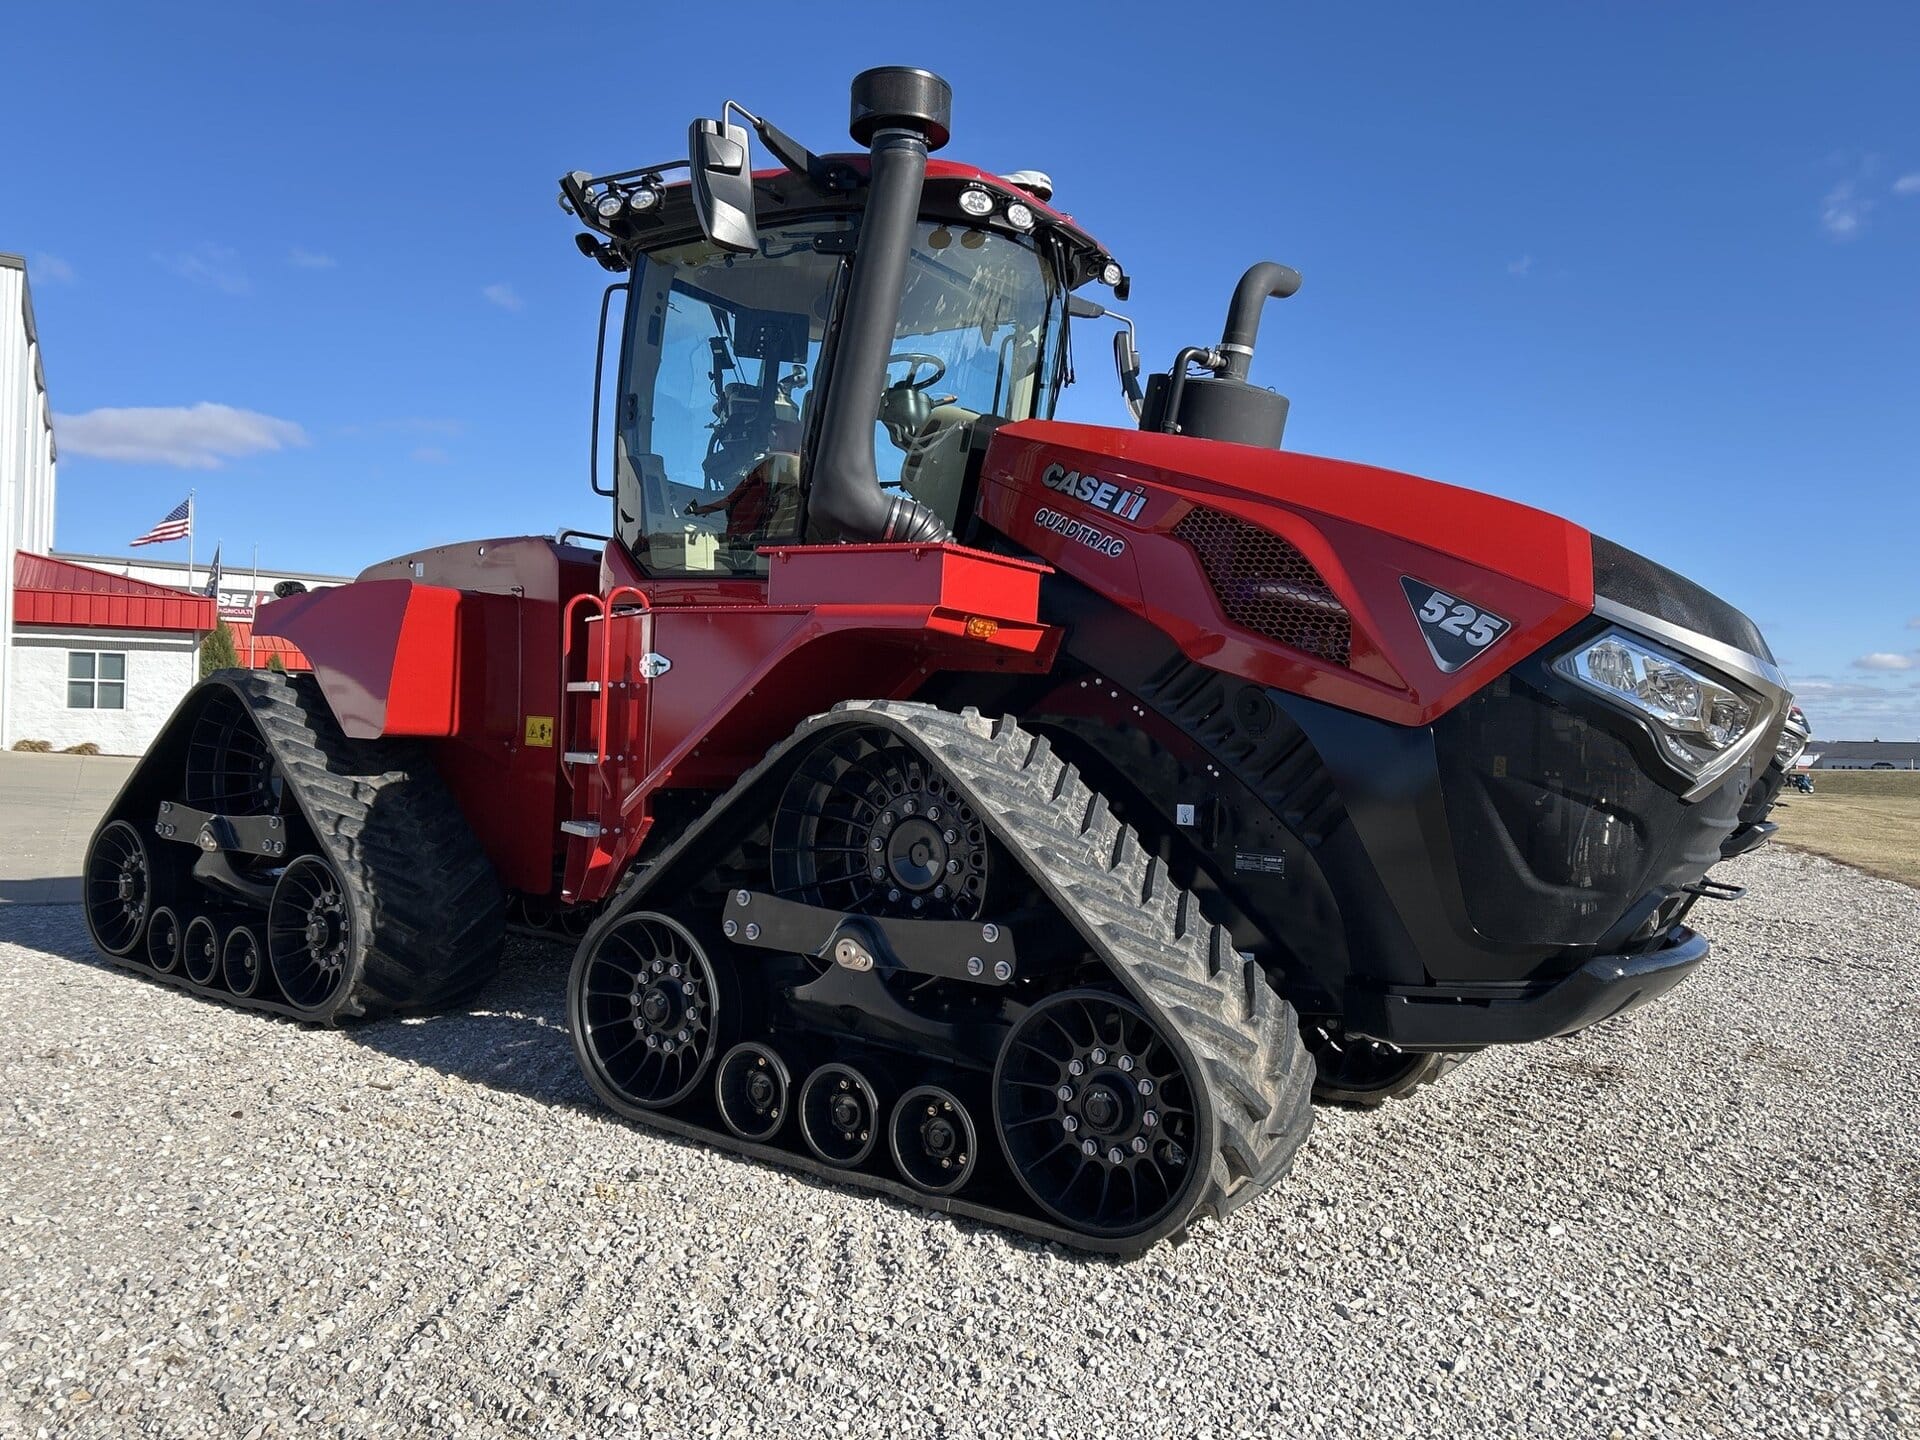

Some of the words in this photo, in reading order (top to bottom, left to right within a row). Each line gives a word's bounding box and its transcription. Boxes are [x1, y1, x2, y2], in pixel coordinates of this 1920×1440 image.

[1041, 462, 1119, 510] CASE
[1034, 507, 1126, 557] QUADTRAC
[218, 592, 248, 607] SE
[1419, 591, 1503, 647] 525
